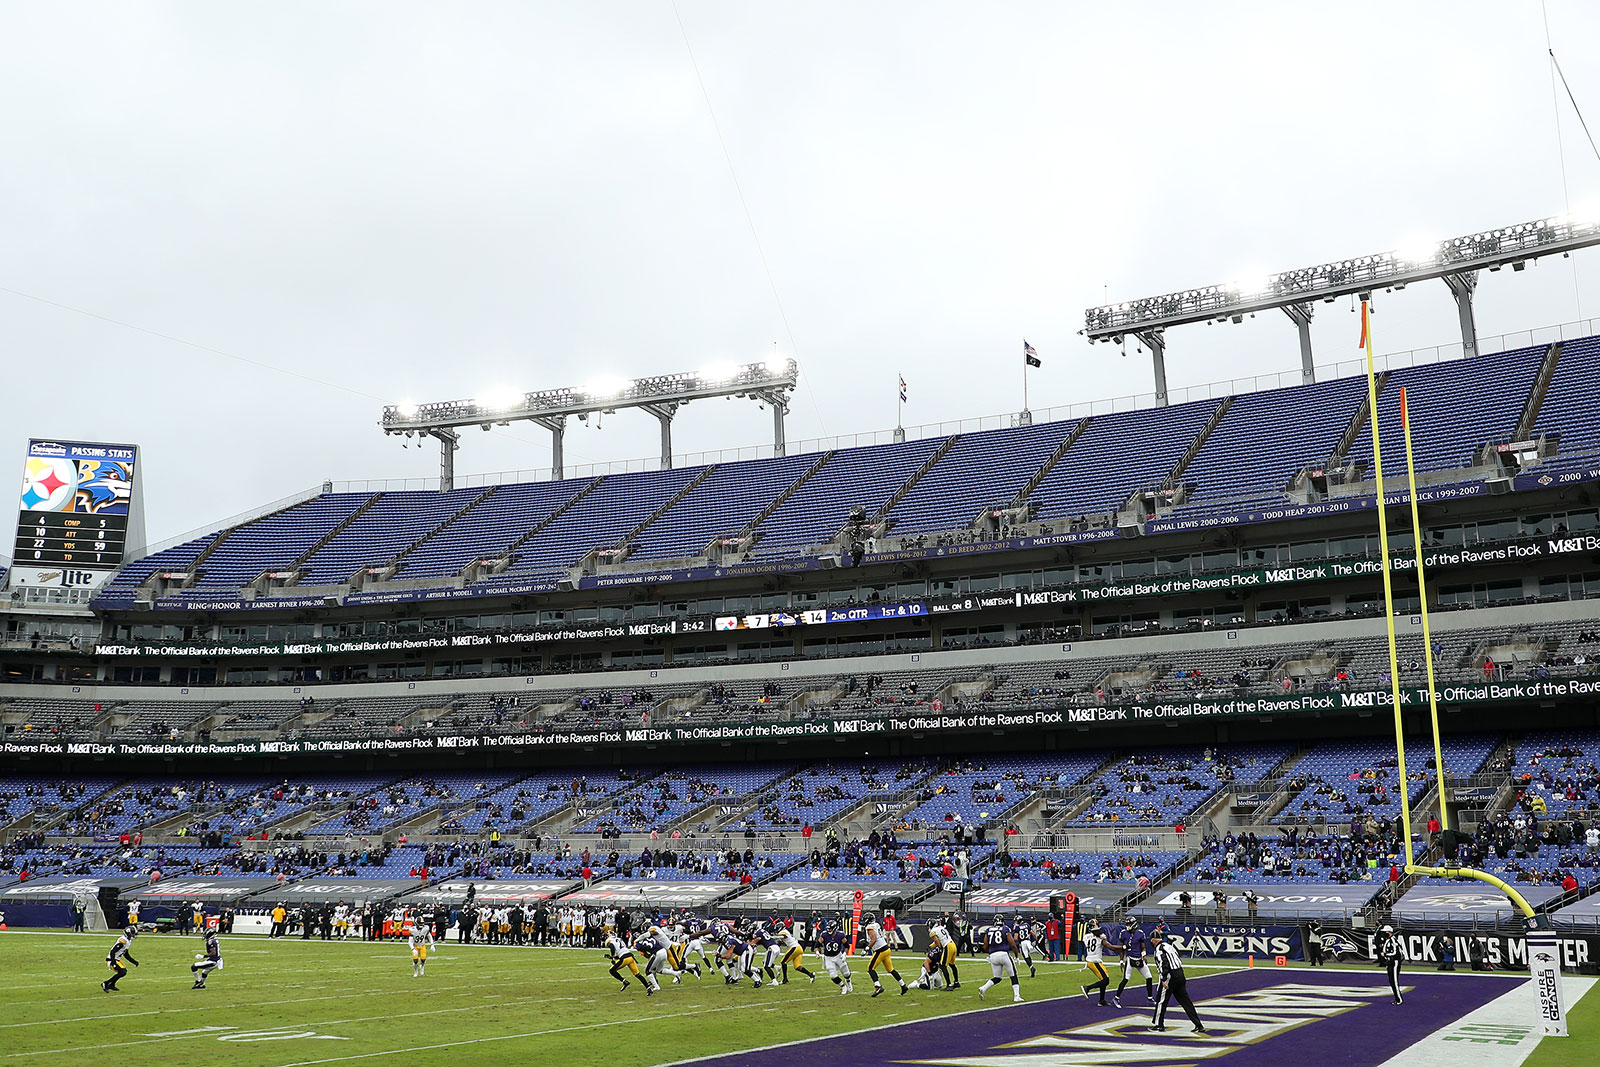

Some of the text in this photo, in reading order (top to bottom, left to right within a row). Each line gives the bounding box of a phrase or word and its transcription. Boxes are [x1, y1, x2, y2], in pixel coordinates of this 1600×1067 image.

[71, 447, 106, 457] PASSING
[108, 449, 132, 458] STATS
[1559, 472, 1581, 482] 2000
[1402, 491, 1434, 504] BILICK
[1436, 485, 1480, 498] 1999-2007
[1261, 502, 1349, 519] TODD HEAP 2001-2010
[38, 516, 45, 525] 4
[99, 519, 106, 528] 5
[1152, 515, 1239, 532] JAMAL LEWIS 2000-2006
[35, 527, 46, 536] 10
[97, 531, 104, 539] 8
[1033, 530, 1115, 545] MATT STOVER 1996-2008
[33, 539, 44, 548] 22
[94, 542, 106, 550] 59
[948, 541, 1010, 555] ED REED 2002-2012
[34, 551, 41, 559] 0
[96, 553, 100, 561] 1
[865, 550, 927, 562] RAY LEWIS 1996-2012
[1331, 564, 1352, 575] The
[1353, 557, 1392, 575] Officil
[1425, 553, 1437, 566] of
[1438, 552, 1459, 565] the
[1461, 549, 1506, 562] Ravens
[1507, 543, 1542, 558] Flock
[726, 562, 808, 575] JONATHAN OGDEN 1996-2007
[60, 569, 93, 587] Lite
[597, 574, 673, 586] PETER BOULWARE 1997-2005
[1080, 573, 1260, 599] The Official Bank of the Ravens Flock
[425, 590, 446, 599] ARTHUR
[452, 588, 473, 597] MODELL
[187, 602, 207, 610] RING
[211, 601, 241, 610] HONOR
[251, 601, 278, 609] EARNEST
[298, 599, 327, 608] 1996-200
[881, 604, 921, 617] 1ST & 10
[932, 598, 972, 612] BALL ON 8
[811, 612, 823, 623] 14
[831, 608, 869, 621] 2ND QTR
[682, 621, 705, 632] 3:42
[754, 617, 761, 627] 7
[495, 626, 625, 643] The Official Bank of the Ravens Flock
[326, 638, 448, 653] The Official Bank of the Ravens Flock
[1443, 686, 1488, 701] Official
[1490, 684, 1525, 698] Bank
[1526, 682, 1541, 696] of
[1542, 682, 1567, 695] the
[1131, 695, 1334, 718] The Official Bank of the Ravens Flock
[889, 711, 1063, 730] The Official Bank of the Ravens Flock
[675, 720, 829, 739] The Official Bank of the Ravens Flock
[4, 742, 38, 753] Ravens
[39, 743, 63, 753] Flock
[1327, 826, 1338, 835] 103
[208, 919, 216, 927] G
[1184, 925, 1266, 934] BALTIMORE
[987, 930, 1003, 944] 78
[1086, 938, 1096, 952] 48
[1168, 935, 1291, 955] RAVENS
[1367, 934, 1437, 962] BACK
[1536, 970, 1550, 1019] INSPIRE
[1547, 971, 1559, 1020] CHANGE
